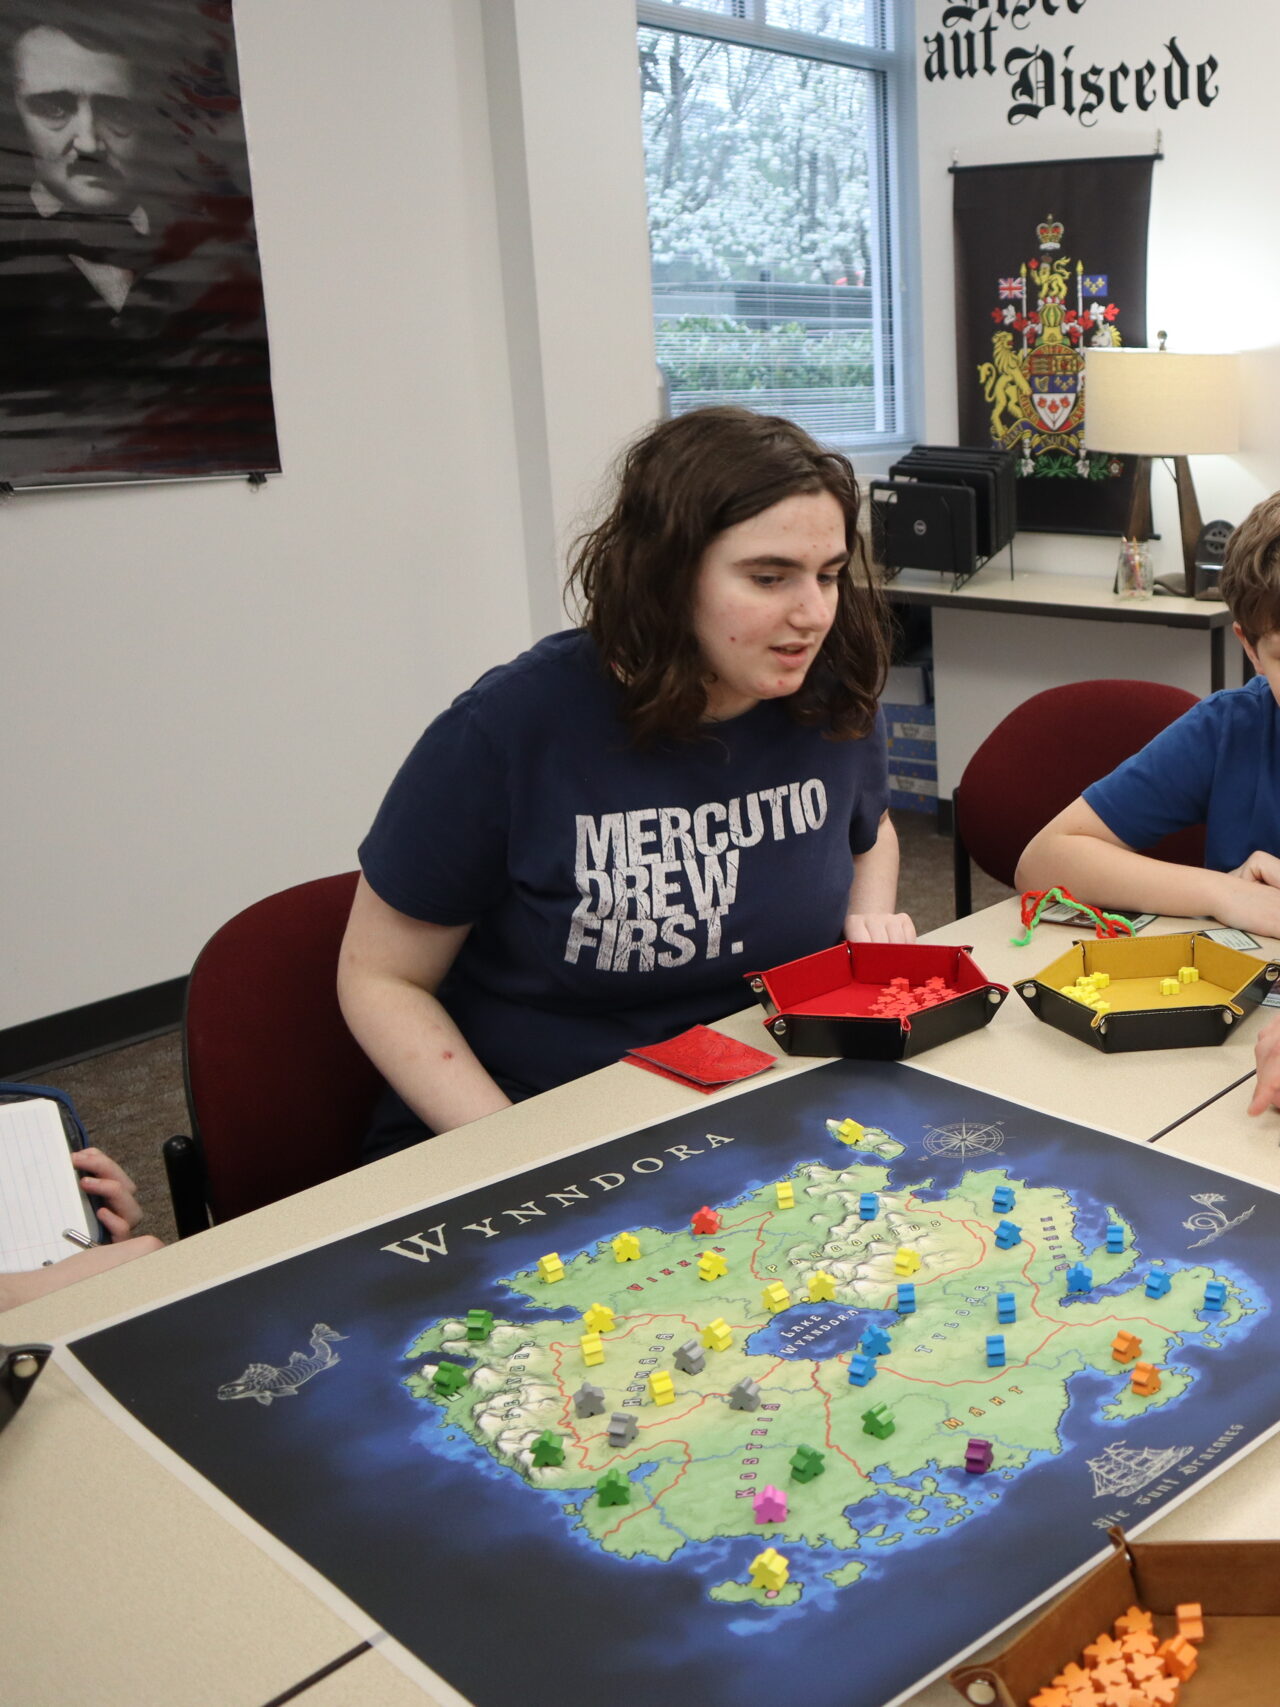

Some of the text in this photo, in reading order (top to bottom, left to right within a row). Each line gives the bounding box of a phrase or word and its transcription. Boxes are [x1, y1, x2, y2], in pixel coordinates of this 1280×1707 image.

[924, 12, 999, 82] aut
[1004, 36, 1219, 128] Discede
[575, 778, 828, 871] MERCUTIO
[574, 849, 740, 920] DREW
[564, 905, 744, 972] FIRST.
[380, 1132, 735, 1263] WYNNDORA
[780, 1315, 821, 1338] LAKE
[780, 1310, 859, 1354] WYNNDORA
